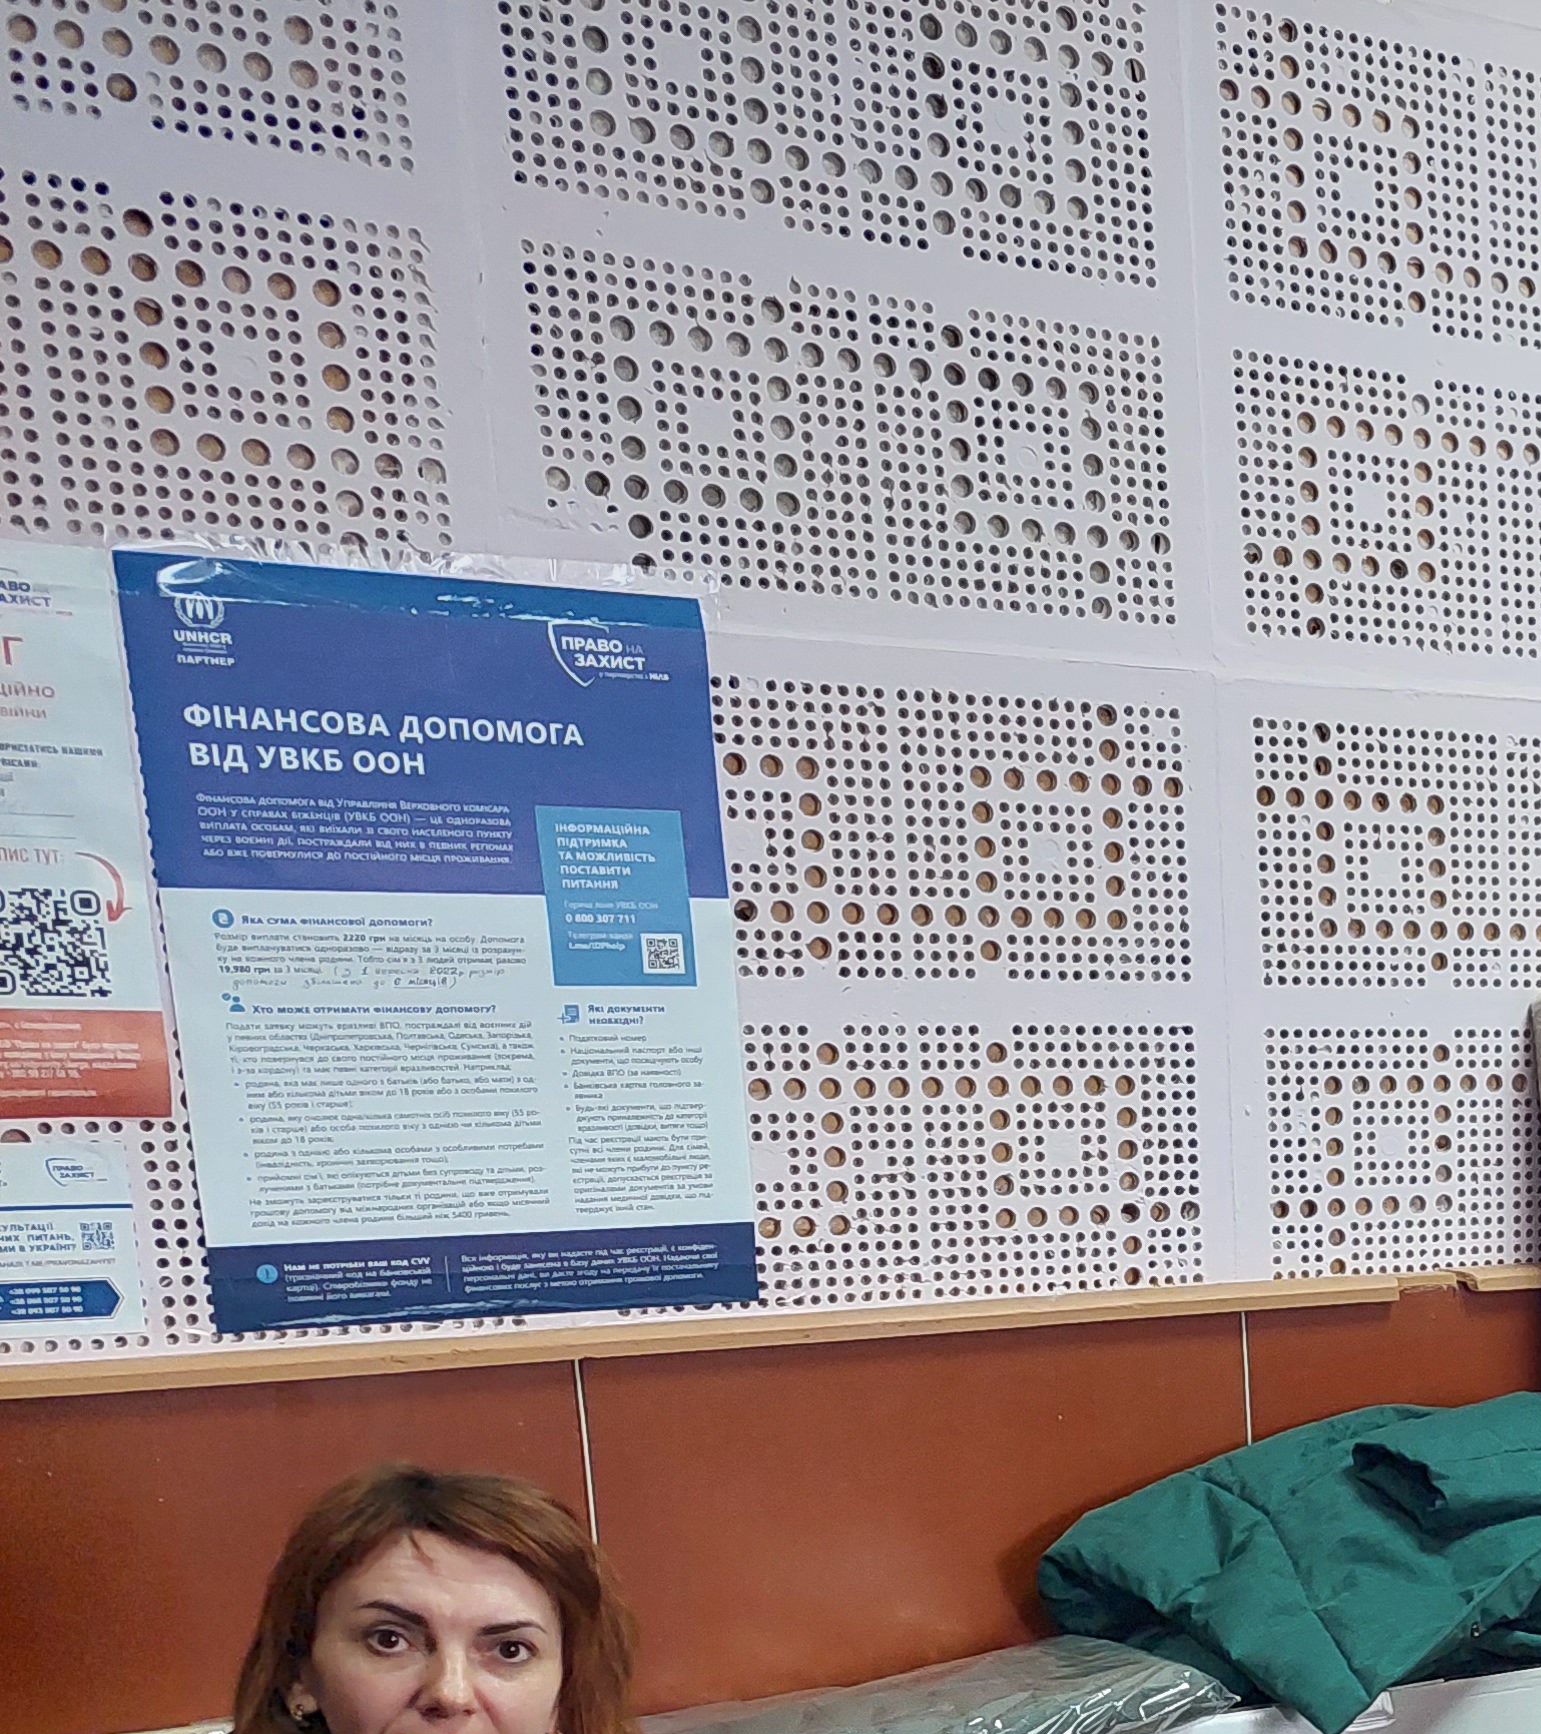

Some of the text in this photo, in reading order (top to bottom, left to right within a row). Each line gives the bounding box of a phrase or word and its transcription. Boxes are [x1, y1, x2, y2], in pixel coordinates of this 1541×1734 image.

[173, 629, 232, 645] UNHCR
[561, 635, 623, 653] ПРАВО
[176, 653, 235, 667] ПАРТНЕР
[574, 653, 646, 671] ЗАХИСТ
[183, 703, 585, 747] ФІНАНСОВА ДОПОМОГА
[188, 742, 427, 776] ВІД УВКБ ООН
[555, 823, 651, 835] ІНФОРМАЦІЙНА
[556, 837, 628, 849] ПІДТРИМКА
[558, 850, 656, 863] ТА МОЖЛИВІСТЬ
[560, 865, 631, 876] ПОСТАВИТИ
[562, 878, 619, 889] ПИТАННЯ
[618, 914, 636, 924] 711
